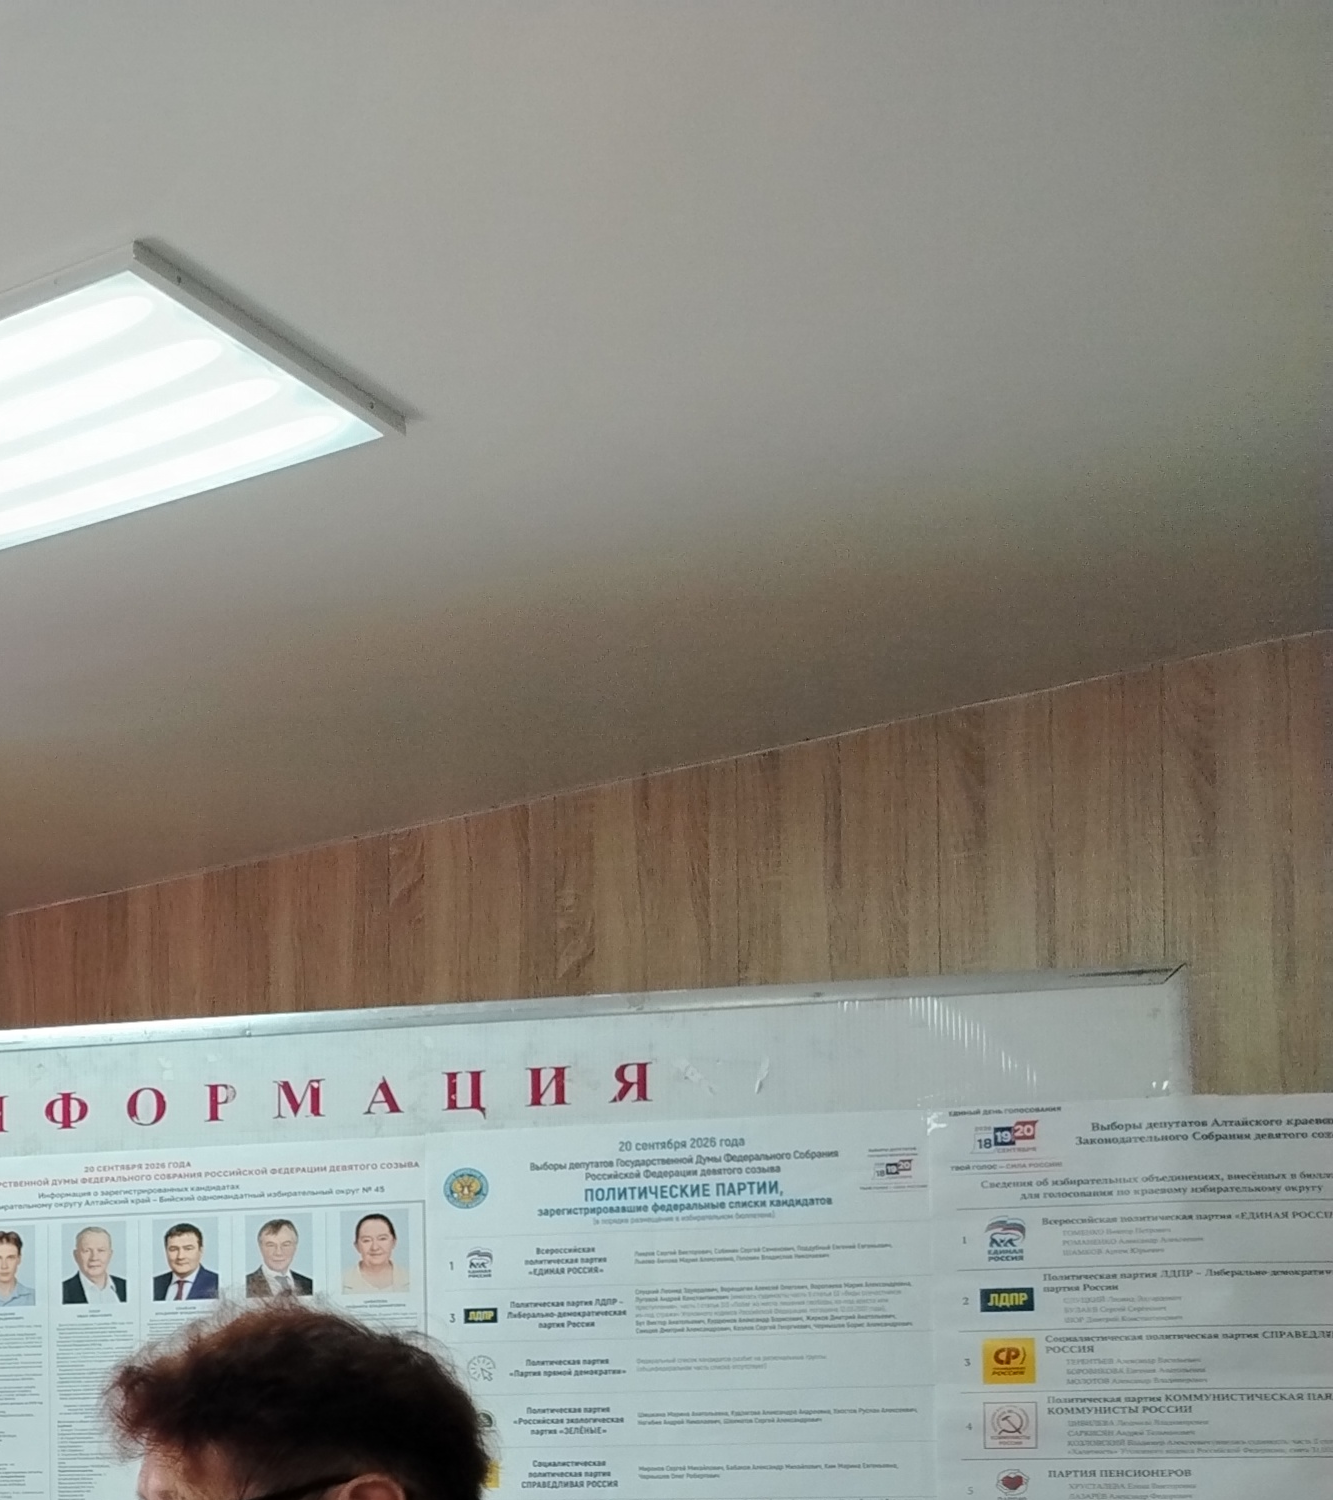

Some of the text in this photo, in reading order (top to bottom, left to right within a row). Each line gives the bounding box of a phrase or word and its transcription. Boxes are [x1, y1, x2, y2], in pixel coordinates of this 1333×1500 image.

[1286, 1118, 1333, 1126] краево
[977, 1125, 1033, 1149] 18 19 20
[584, 1180, 784, 1202] ПОЛИТИЧЕСКИЕ ПАРТИИ,
[1292, 1211, 1333, 1219] РОССИ
[1205, 1269, 1332, 1277] Либерально-демократи
[988, 1293, 1028, 1307] ЛДПР
[1262, 1330, 1333, 1339] СПРАВЕДЛ
